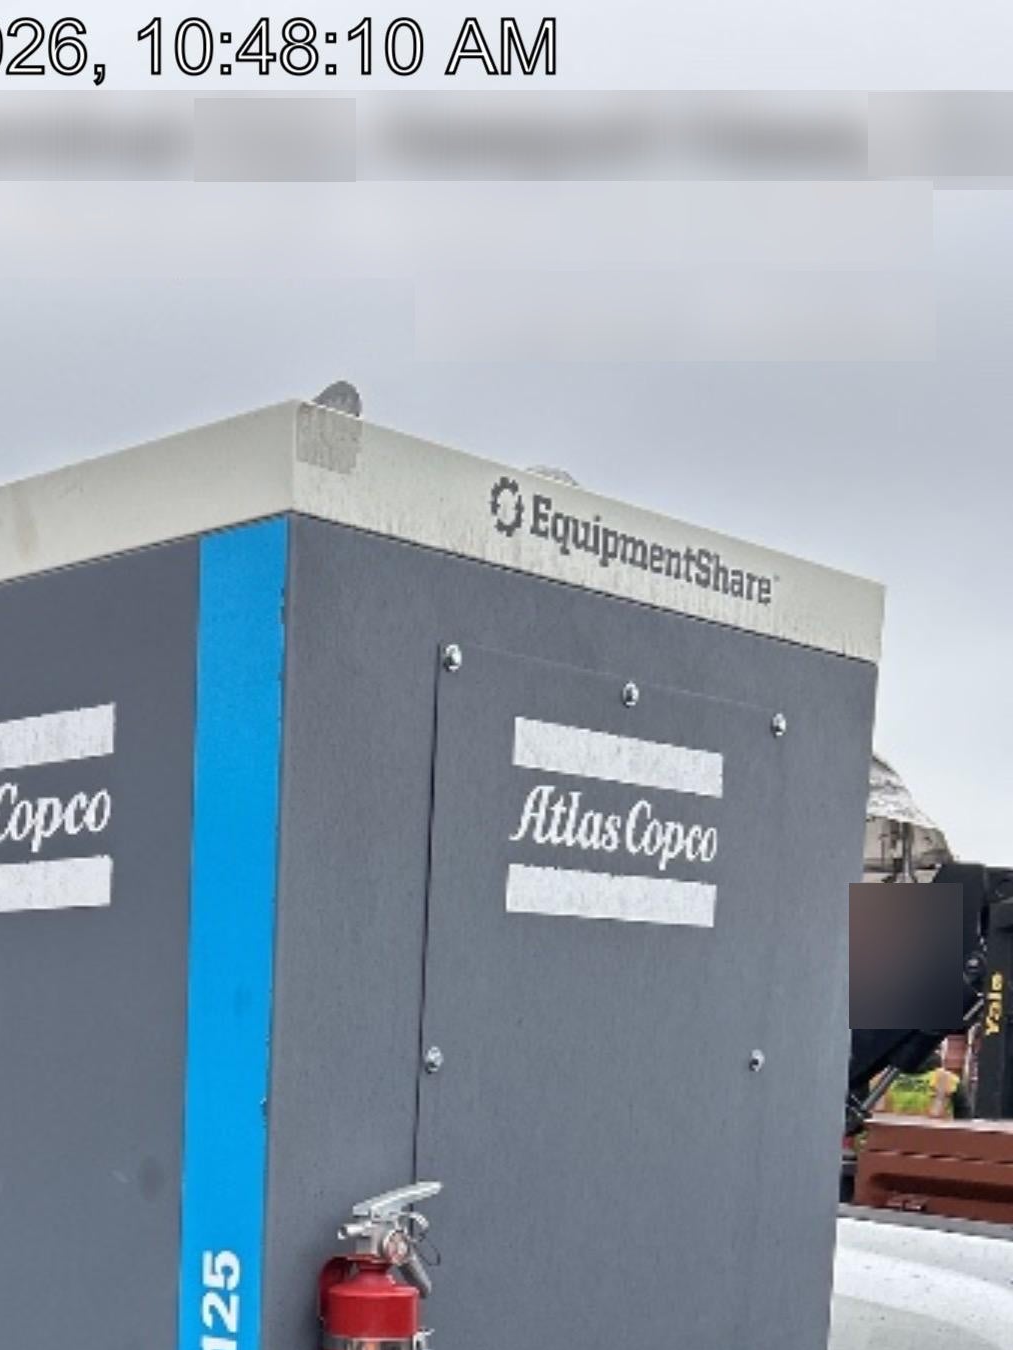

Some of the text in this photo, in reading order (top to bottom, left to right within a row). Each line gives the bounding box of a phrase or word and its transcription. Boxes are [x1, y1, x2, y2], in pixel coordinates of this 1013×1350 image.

[529, 494, 773, 605] EquipmentShare
[509, 785, 718, 871] Atlas Copco
